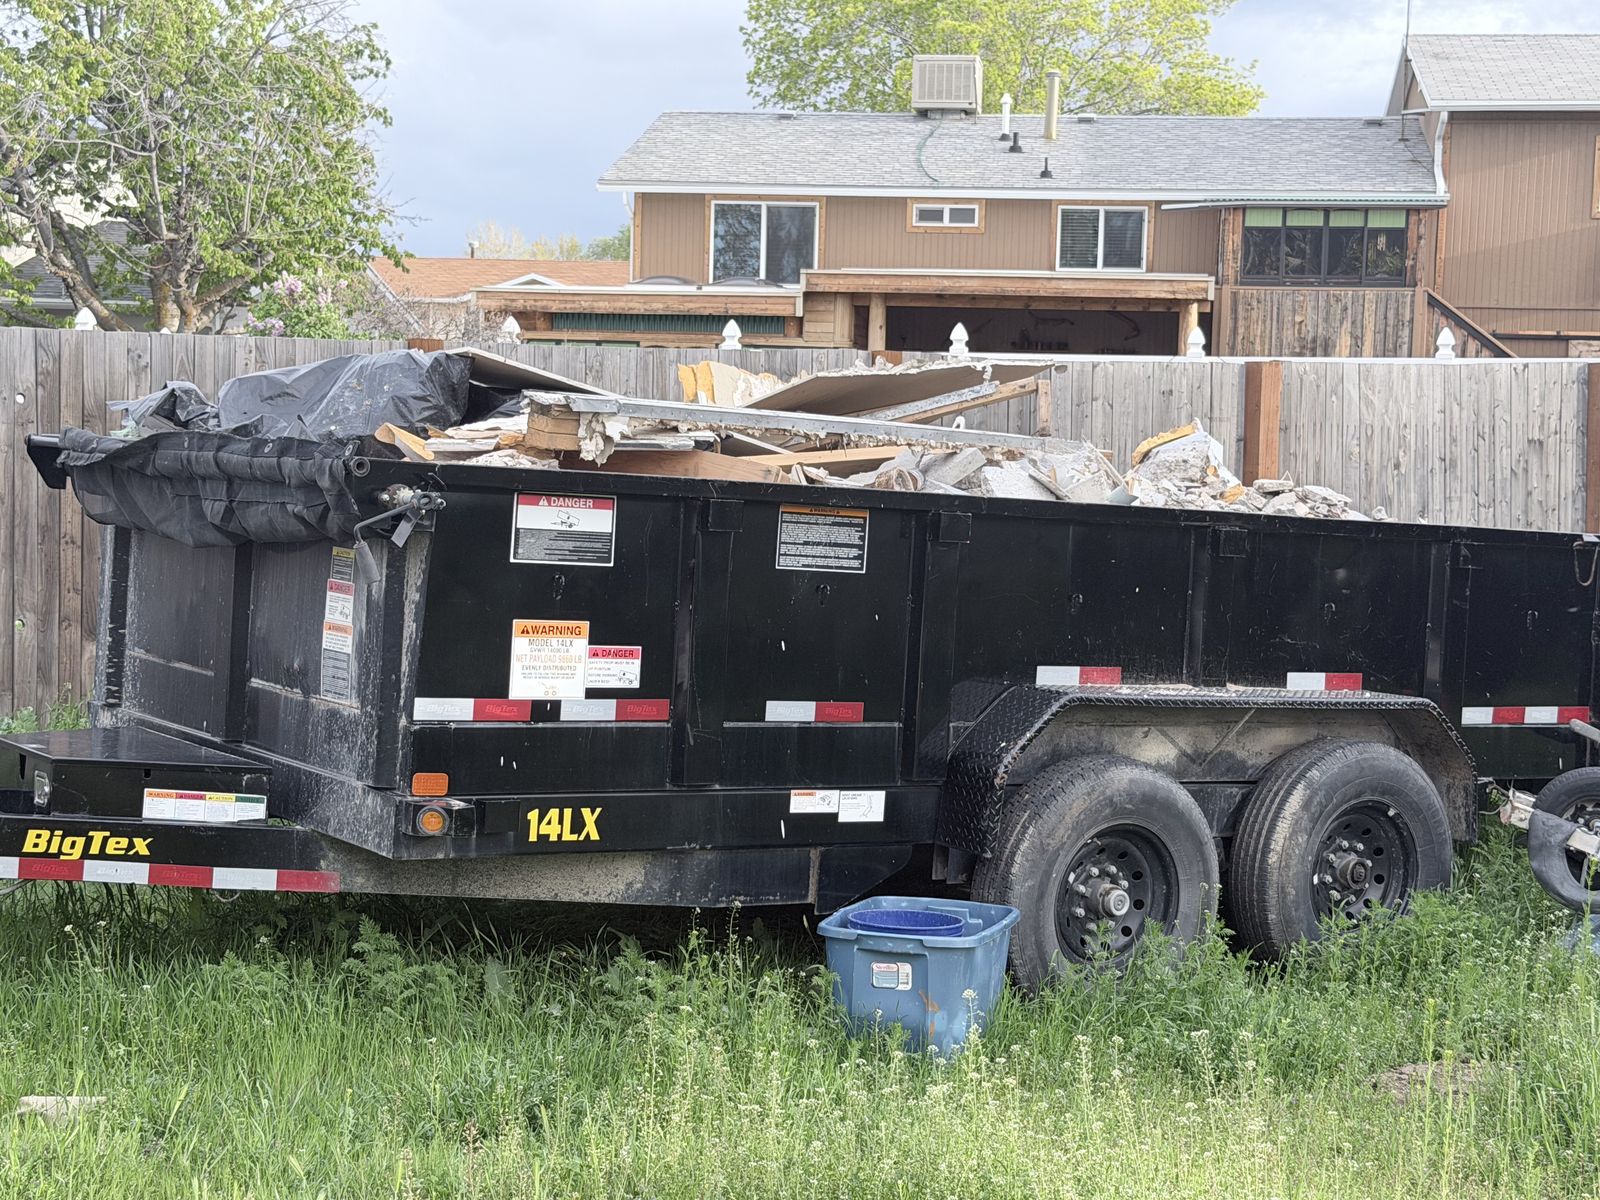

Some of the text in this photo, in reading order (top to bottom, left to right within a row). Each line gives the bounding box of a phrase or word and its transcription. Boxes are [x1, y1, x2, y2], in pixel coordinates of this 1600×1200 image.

[550, 496, 594, 508] DANGER
[530, 625, 582, 636] WARNING
[528, 638, 574, 647] MODEL 14LX
[601, 649, 634, 658] DANGER
[515, 654, 528, 663] NET
[529, 654, 557, 664] PAYLOAD
[484, 704, 519, 714] BigTex
[526, 807, 602, 842] 14LX
[22, 829, 153, 860] BigTex
